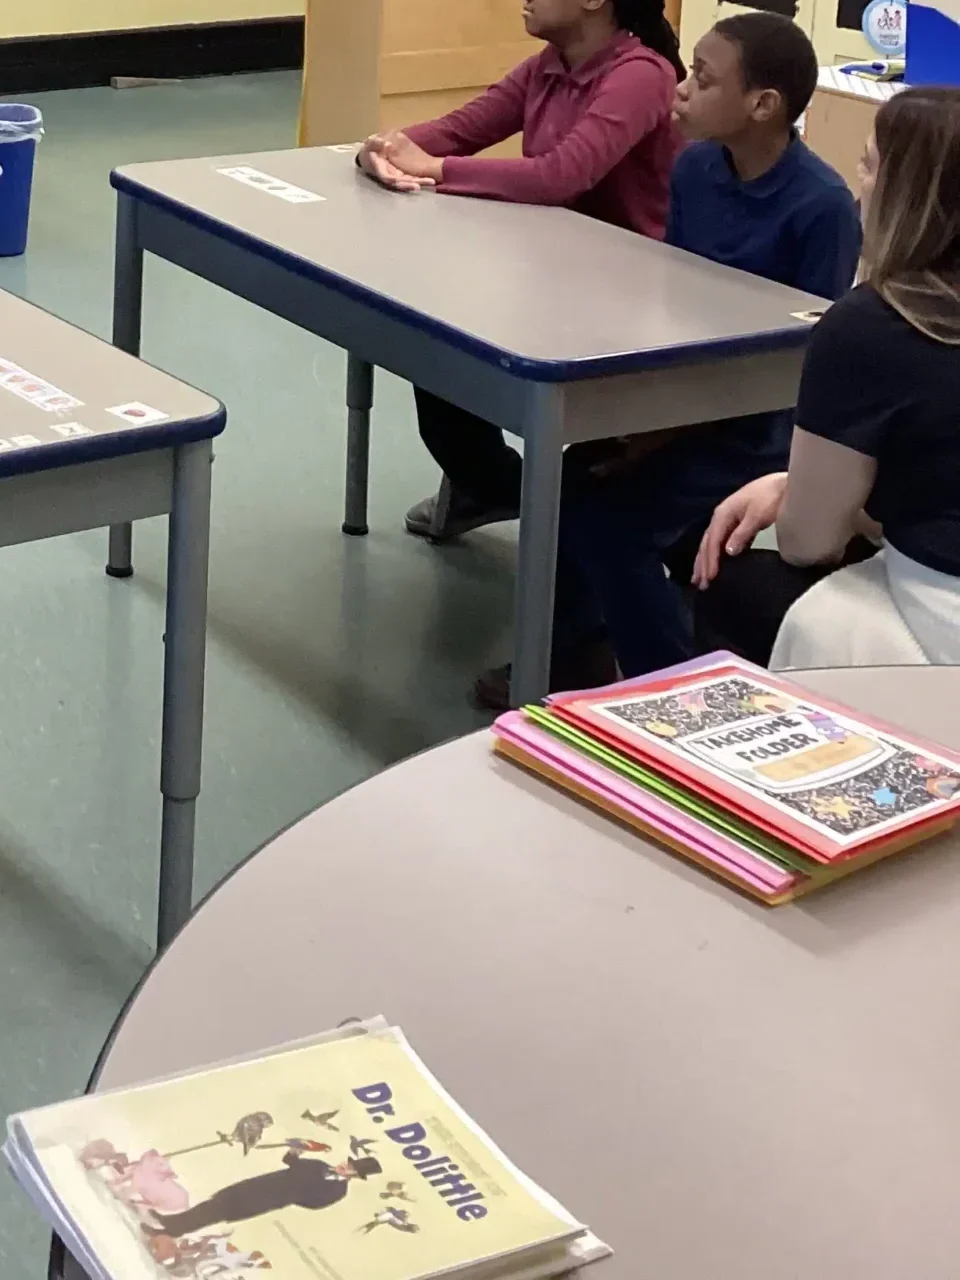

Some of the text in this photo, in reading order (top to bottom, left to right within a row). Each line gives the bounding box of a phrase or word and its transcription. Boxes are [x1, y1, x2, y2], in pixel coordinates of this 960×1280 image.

[693, 715, 803, 750] TAKEHOME
[736, 732, 820, 762] FOLDER
[351, 1082, 396, 1124] Dr.
[384, 1122, 488, 1222] Dolittle
